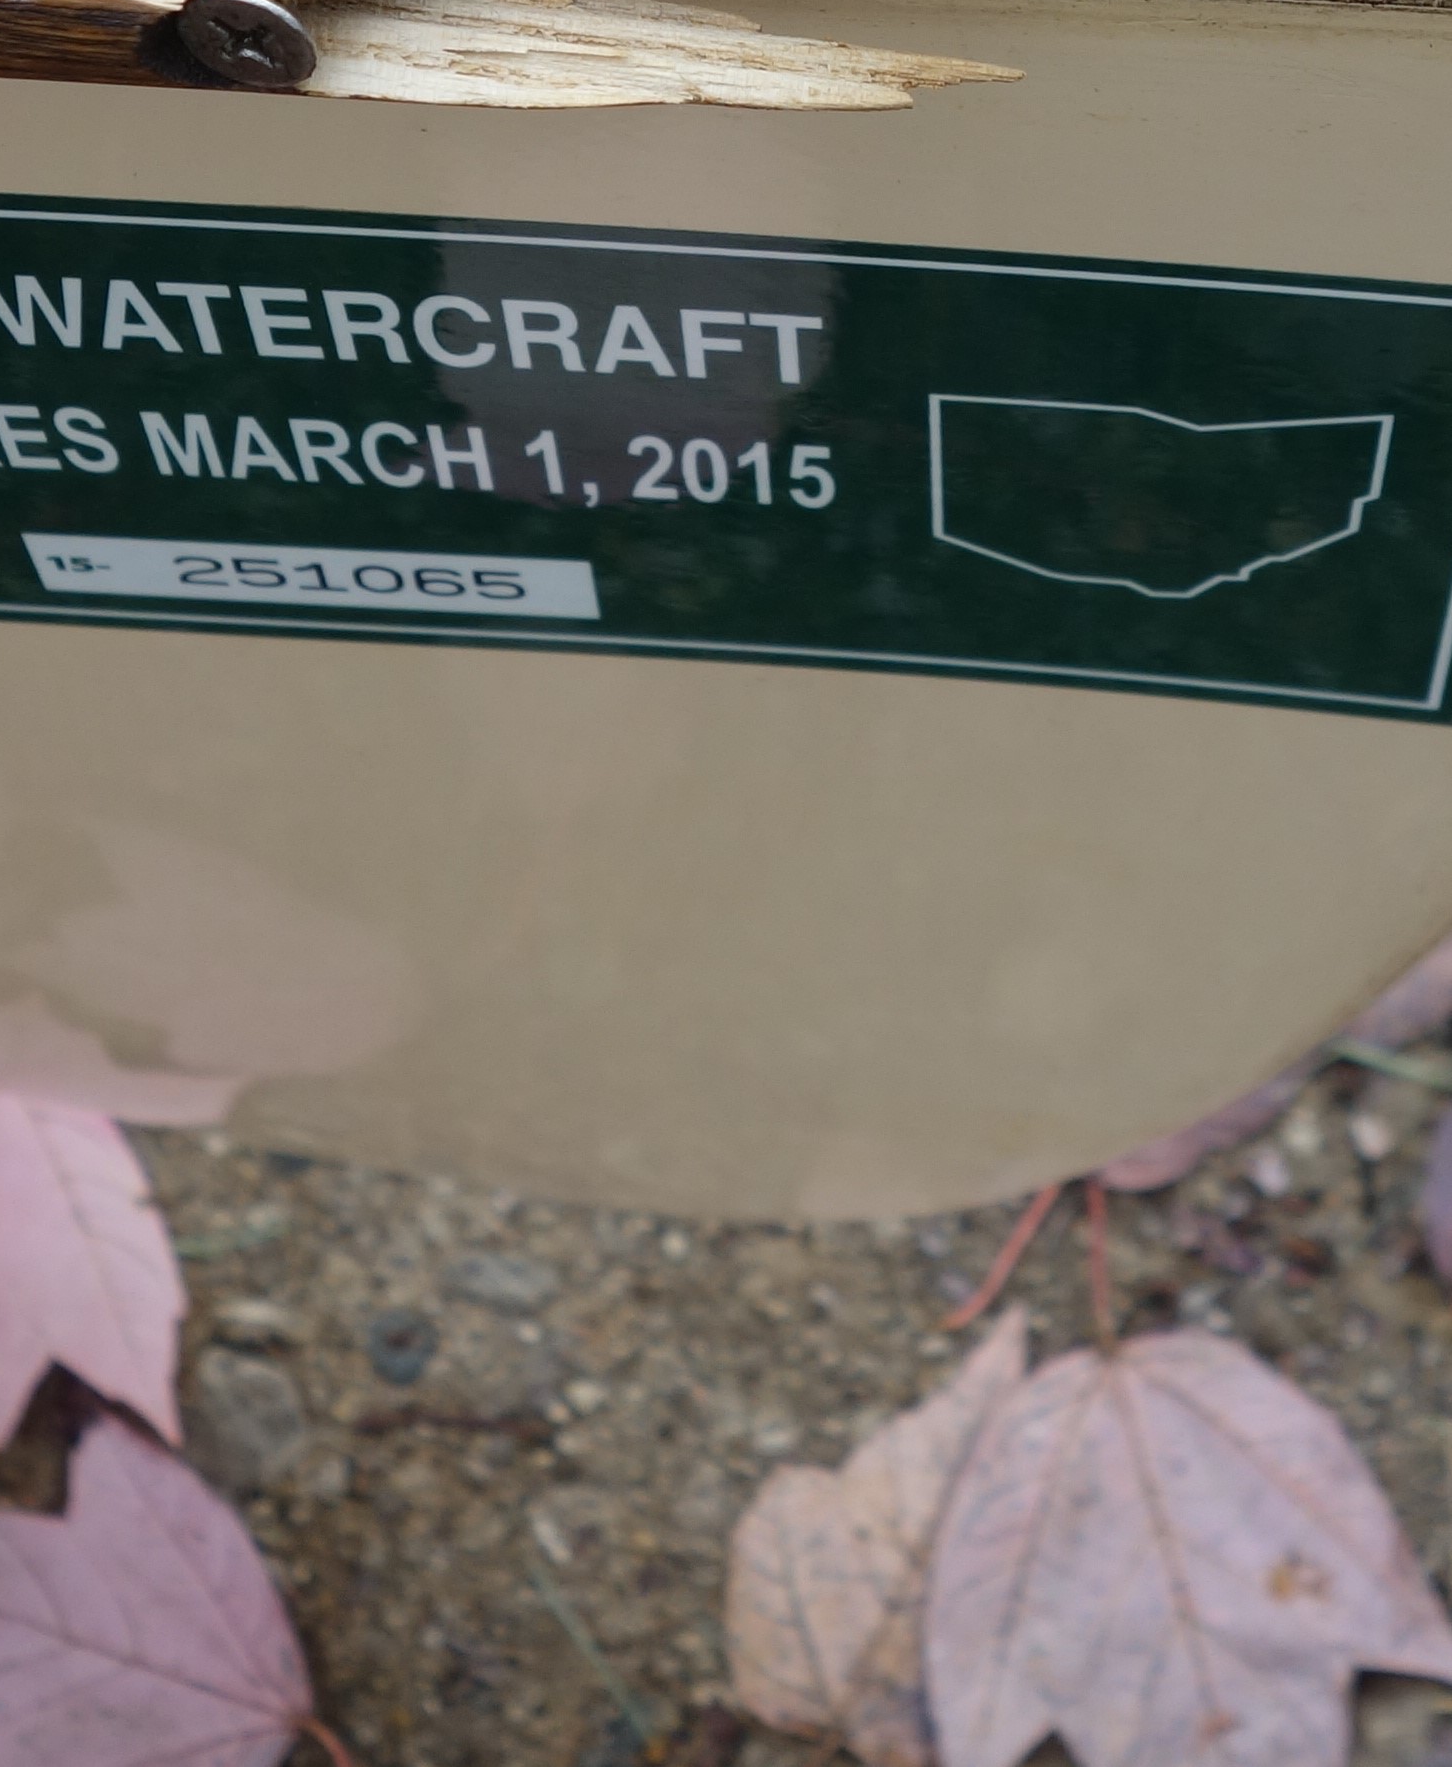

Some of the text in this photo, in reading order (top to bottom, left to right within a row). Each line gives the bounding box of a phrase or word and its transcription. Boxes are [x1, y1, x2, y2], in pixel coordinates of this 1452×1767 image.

[138, 410, 496, 492] MARCH
[523, 428, 604, 510] 1,
[626, 433, 836, 510] 2015
[171, 554, 528, 602] 251065
